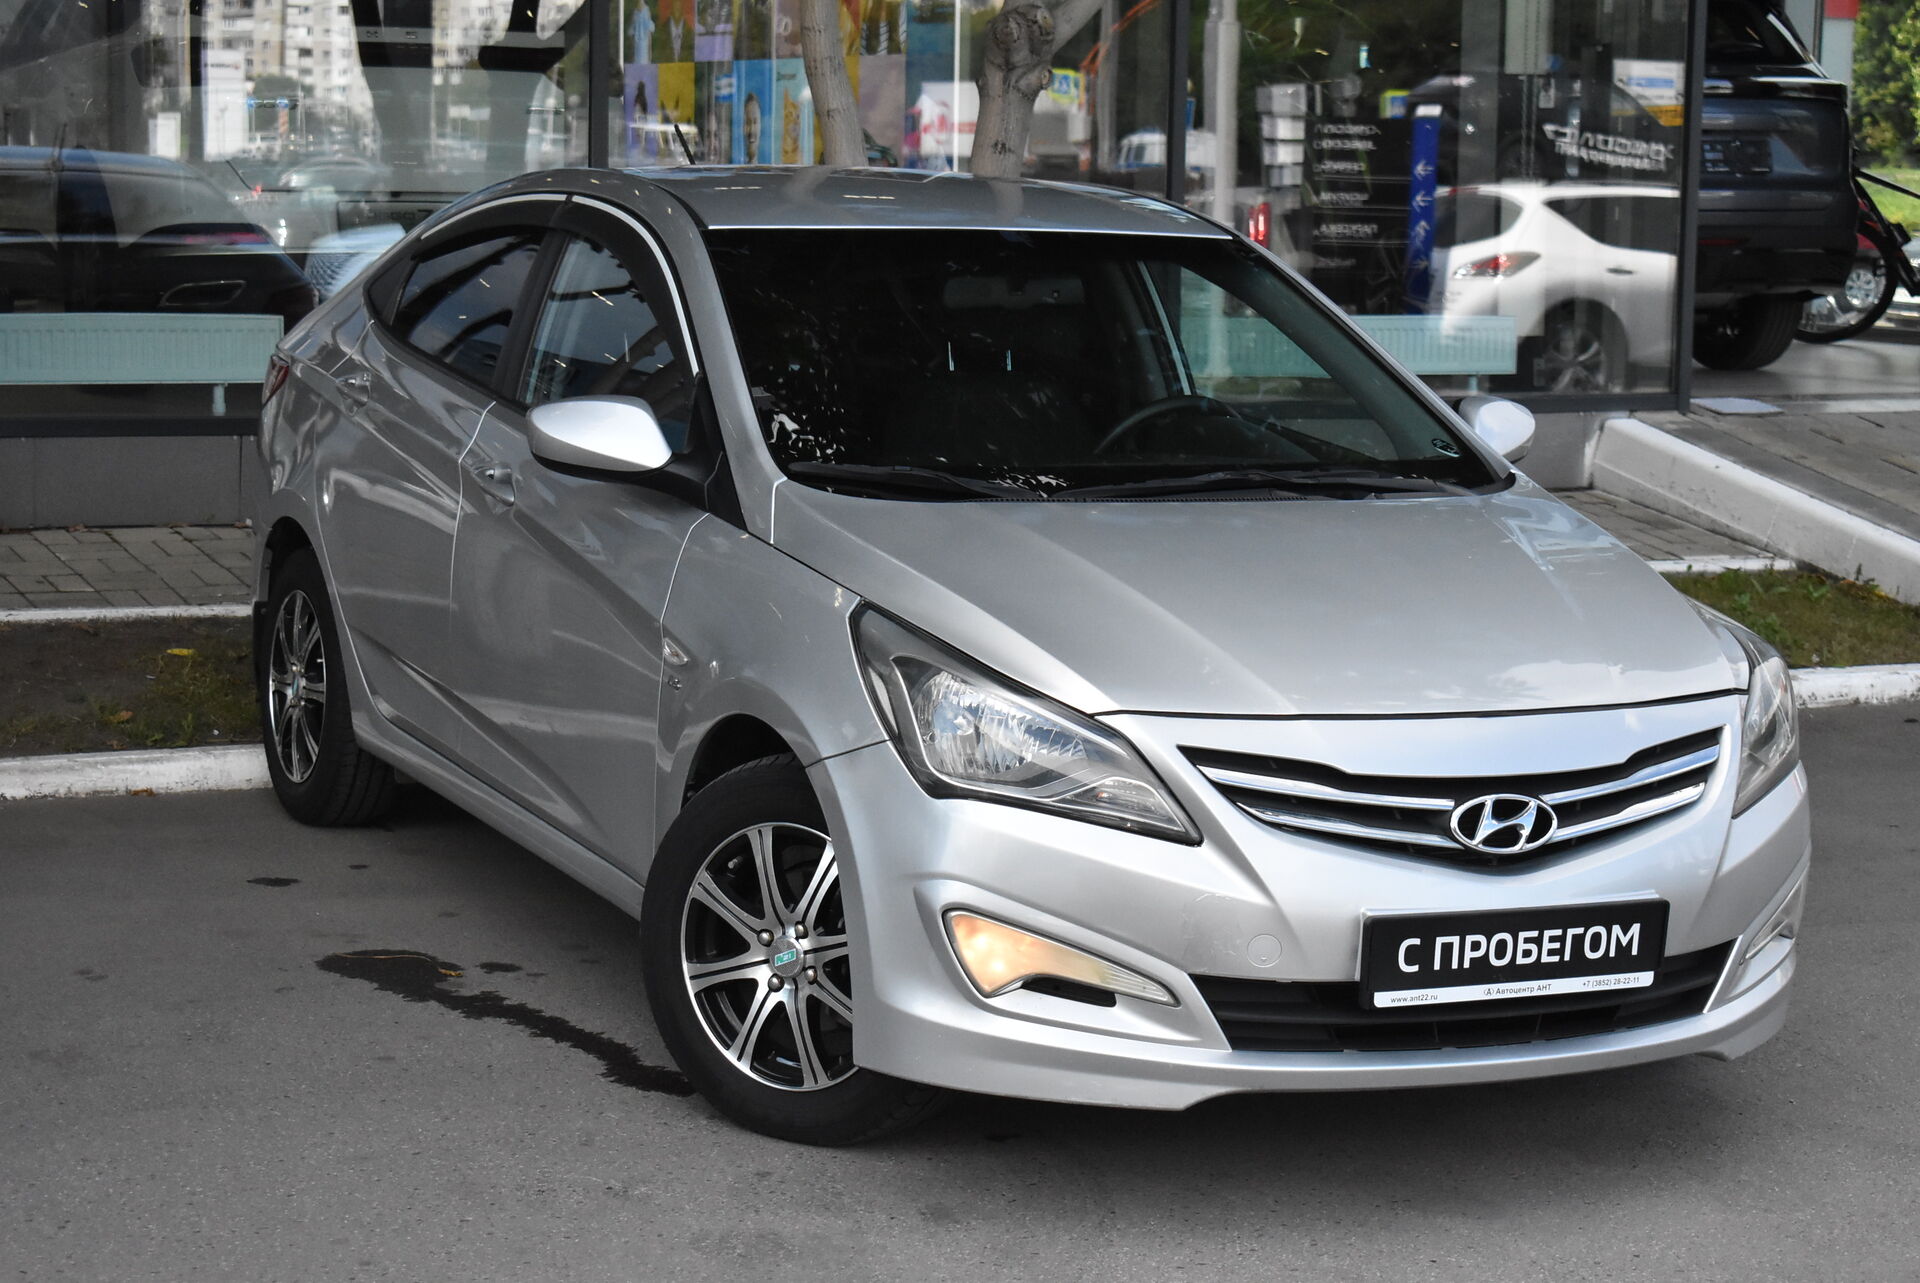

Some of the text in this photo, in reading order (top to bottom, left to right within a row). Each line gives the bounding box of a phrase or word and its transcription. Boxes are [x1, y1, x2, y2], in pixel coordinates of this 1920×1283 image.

[1398, 923, 1641, 973] С ПРОБЕГОМ
[1582, 976, 1640, 988] +7 (3852) 28-22-11
[1495, 983, 1552, 996] Автоцентр АНТ
[1390, 993, 1438, 1004] www.ant22.ru
